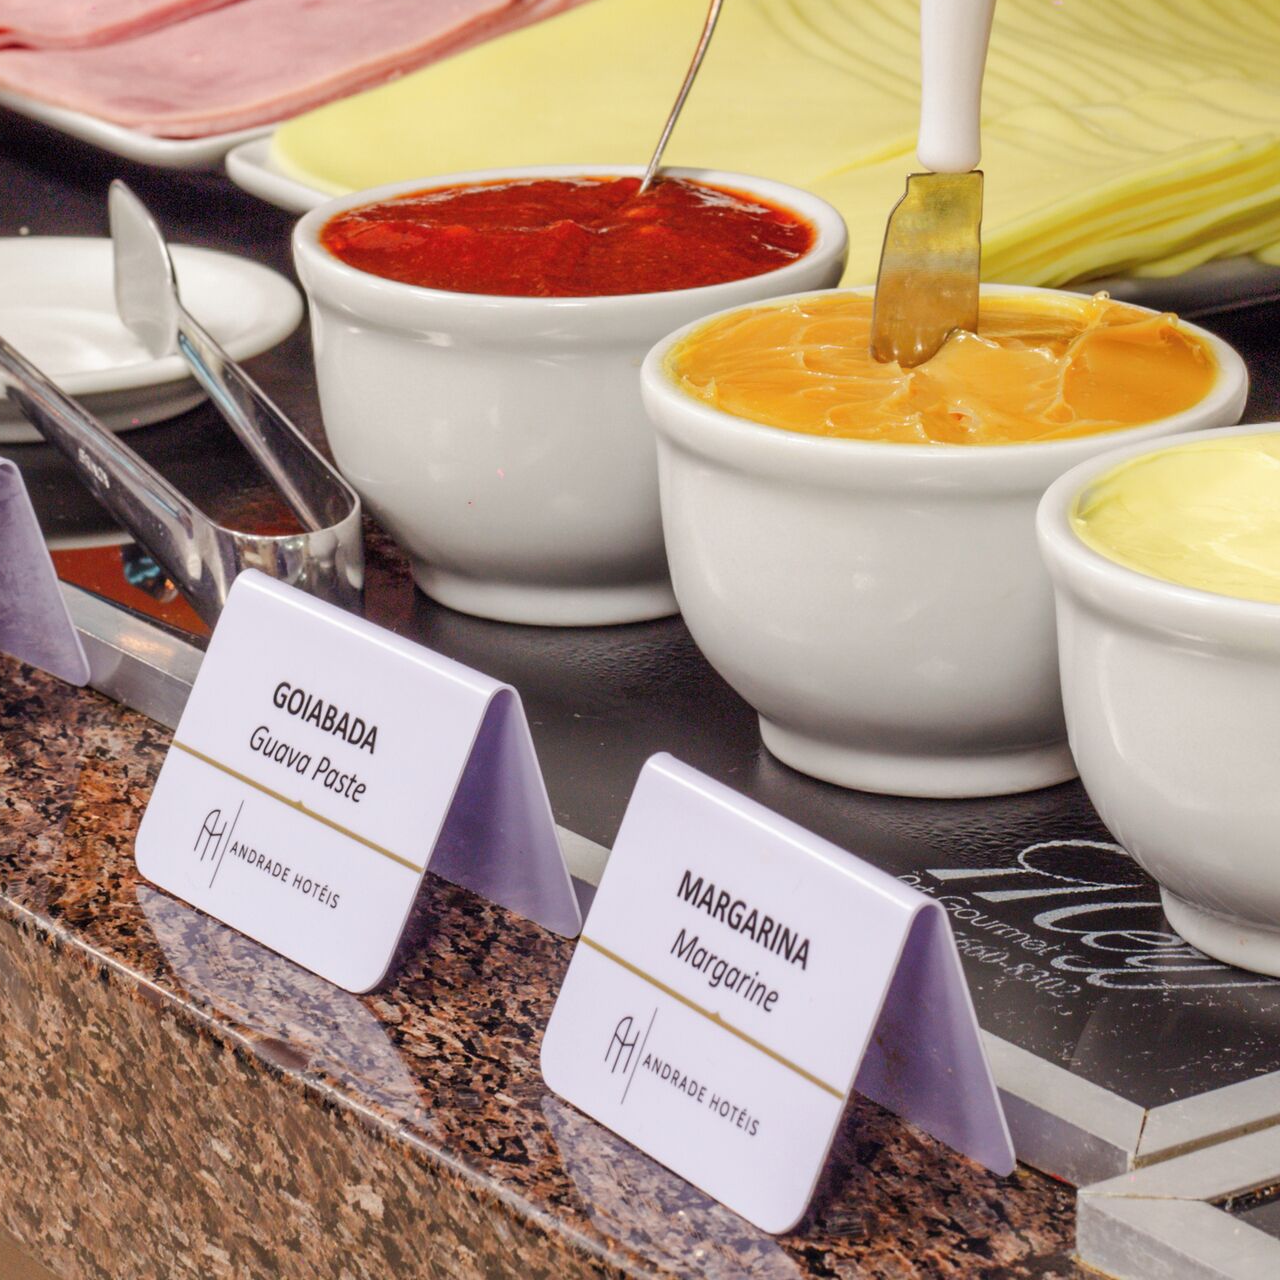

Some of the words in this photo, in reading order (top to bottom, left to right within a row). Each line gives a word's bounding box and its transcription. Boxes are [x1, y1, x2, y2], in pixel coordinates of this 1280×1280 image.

[272, 681, 379, 755] GOIABADA
[249, 725, 310, 775] Guava
[311, 756, 367, 803] Paste
[229, 840, 291, 883] ANDRADE
[292, 871, 340, 910] HOTÉIS
[676, 870, 812, 971] MARGARINA
[937, 895, 1062, 957] Gourmet
[669, 928, 780, 1013] Margarine
[642, 1052, 708, 1104] ANDRADE
[709, 1091, 761, 1136] HOTÉIS
